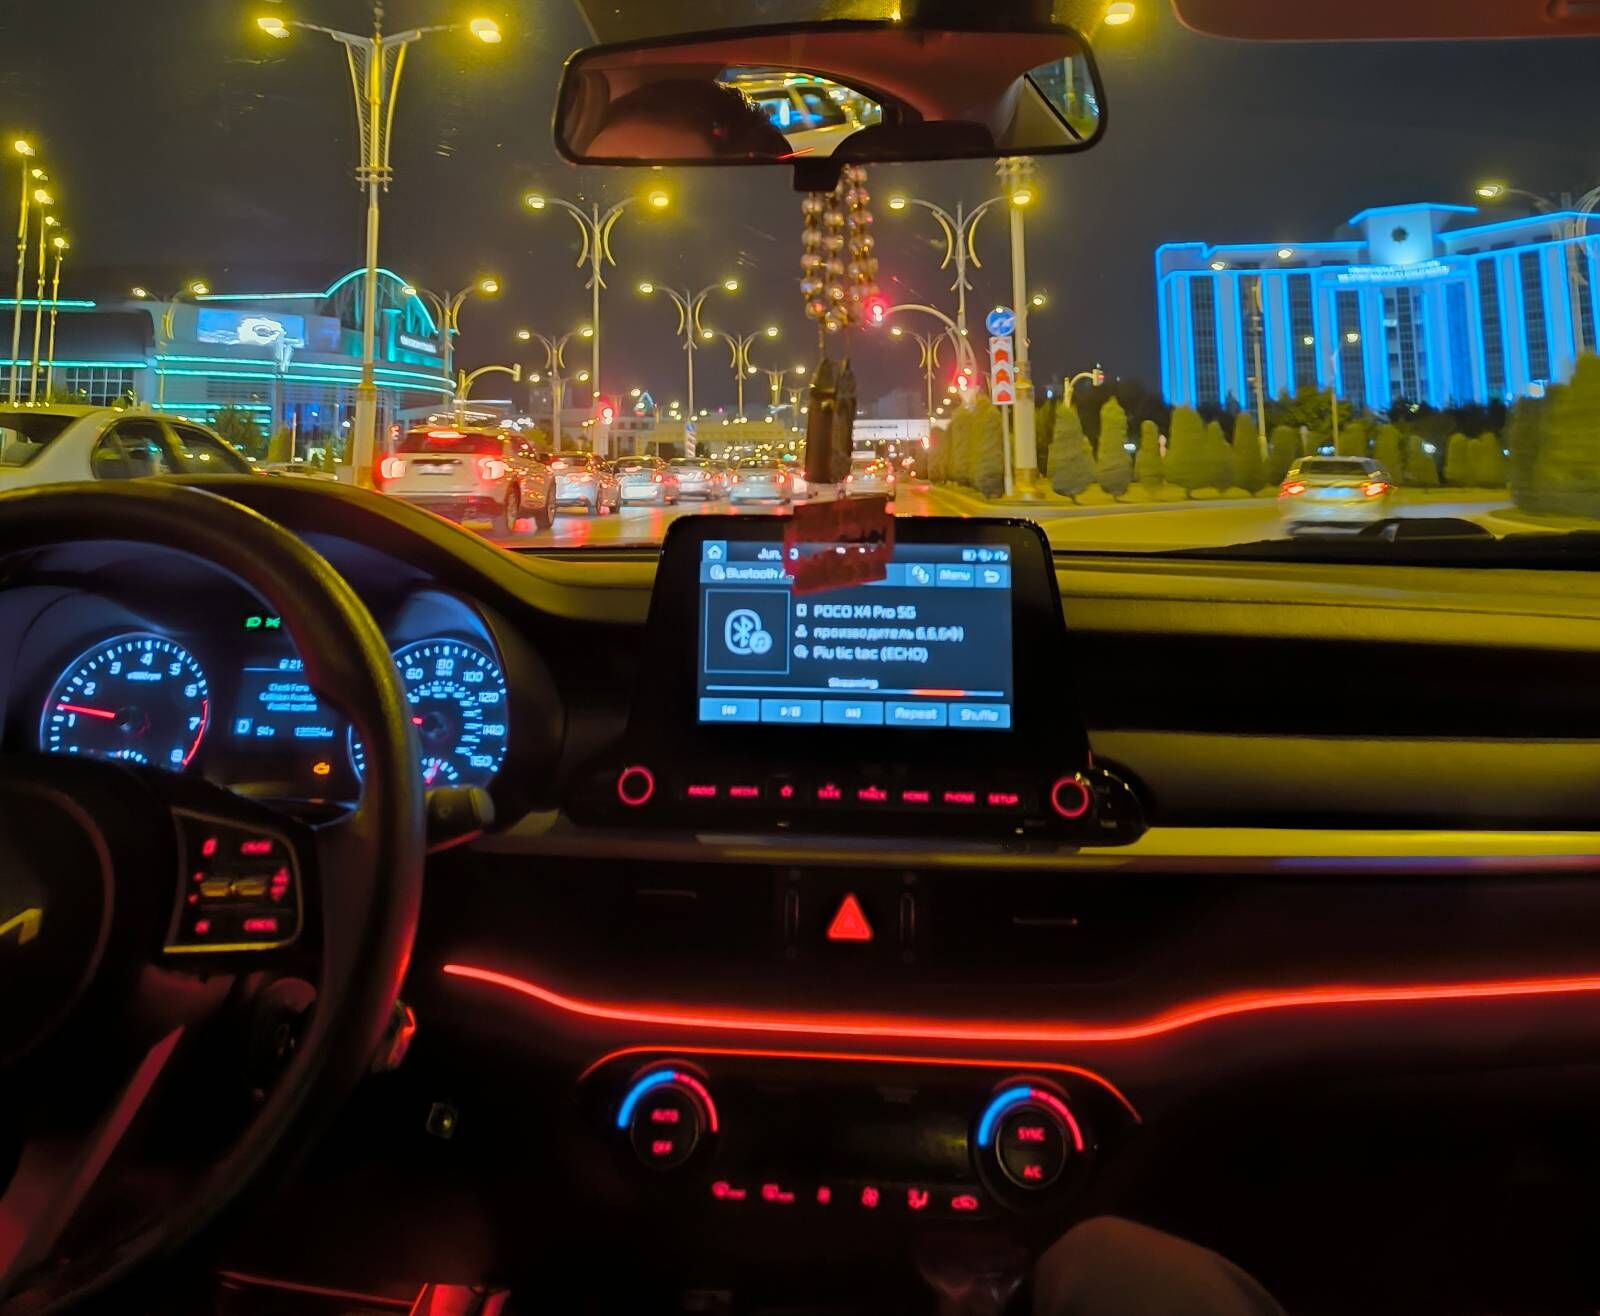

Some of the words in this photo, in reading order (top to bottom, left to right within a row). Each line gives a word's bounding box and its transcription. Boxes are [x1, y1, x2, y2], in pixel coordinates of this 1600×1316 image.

[726, 567, 779, 579] Bluetooth
[814, 605, 852, 619] POCO
[854, 605, 871, 619] X4
[873, 606, 896, 619] Pro
[814, 627, 914, 641] производитель
[140, 652, 153, 666] 4
[109, 661, 121, 675] 3
[170, 662, 181, 676] 5
[463, 671, 484, 682] 100
[83, 681, 96, 696] 2
[67, 713, 76, 728] 1
[895, 707, 938, 721] Repeat
[960, 710, 998, 722] Shuffle
[188, 716, 200, 731] 7
[688, 785, 716, 796] RADIO
[988, 793, 1018, 805] SETUP
[652, 1109, 678, 1123] AUTO
[1018, 1127, 1045, 1140] SYNC
